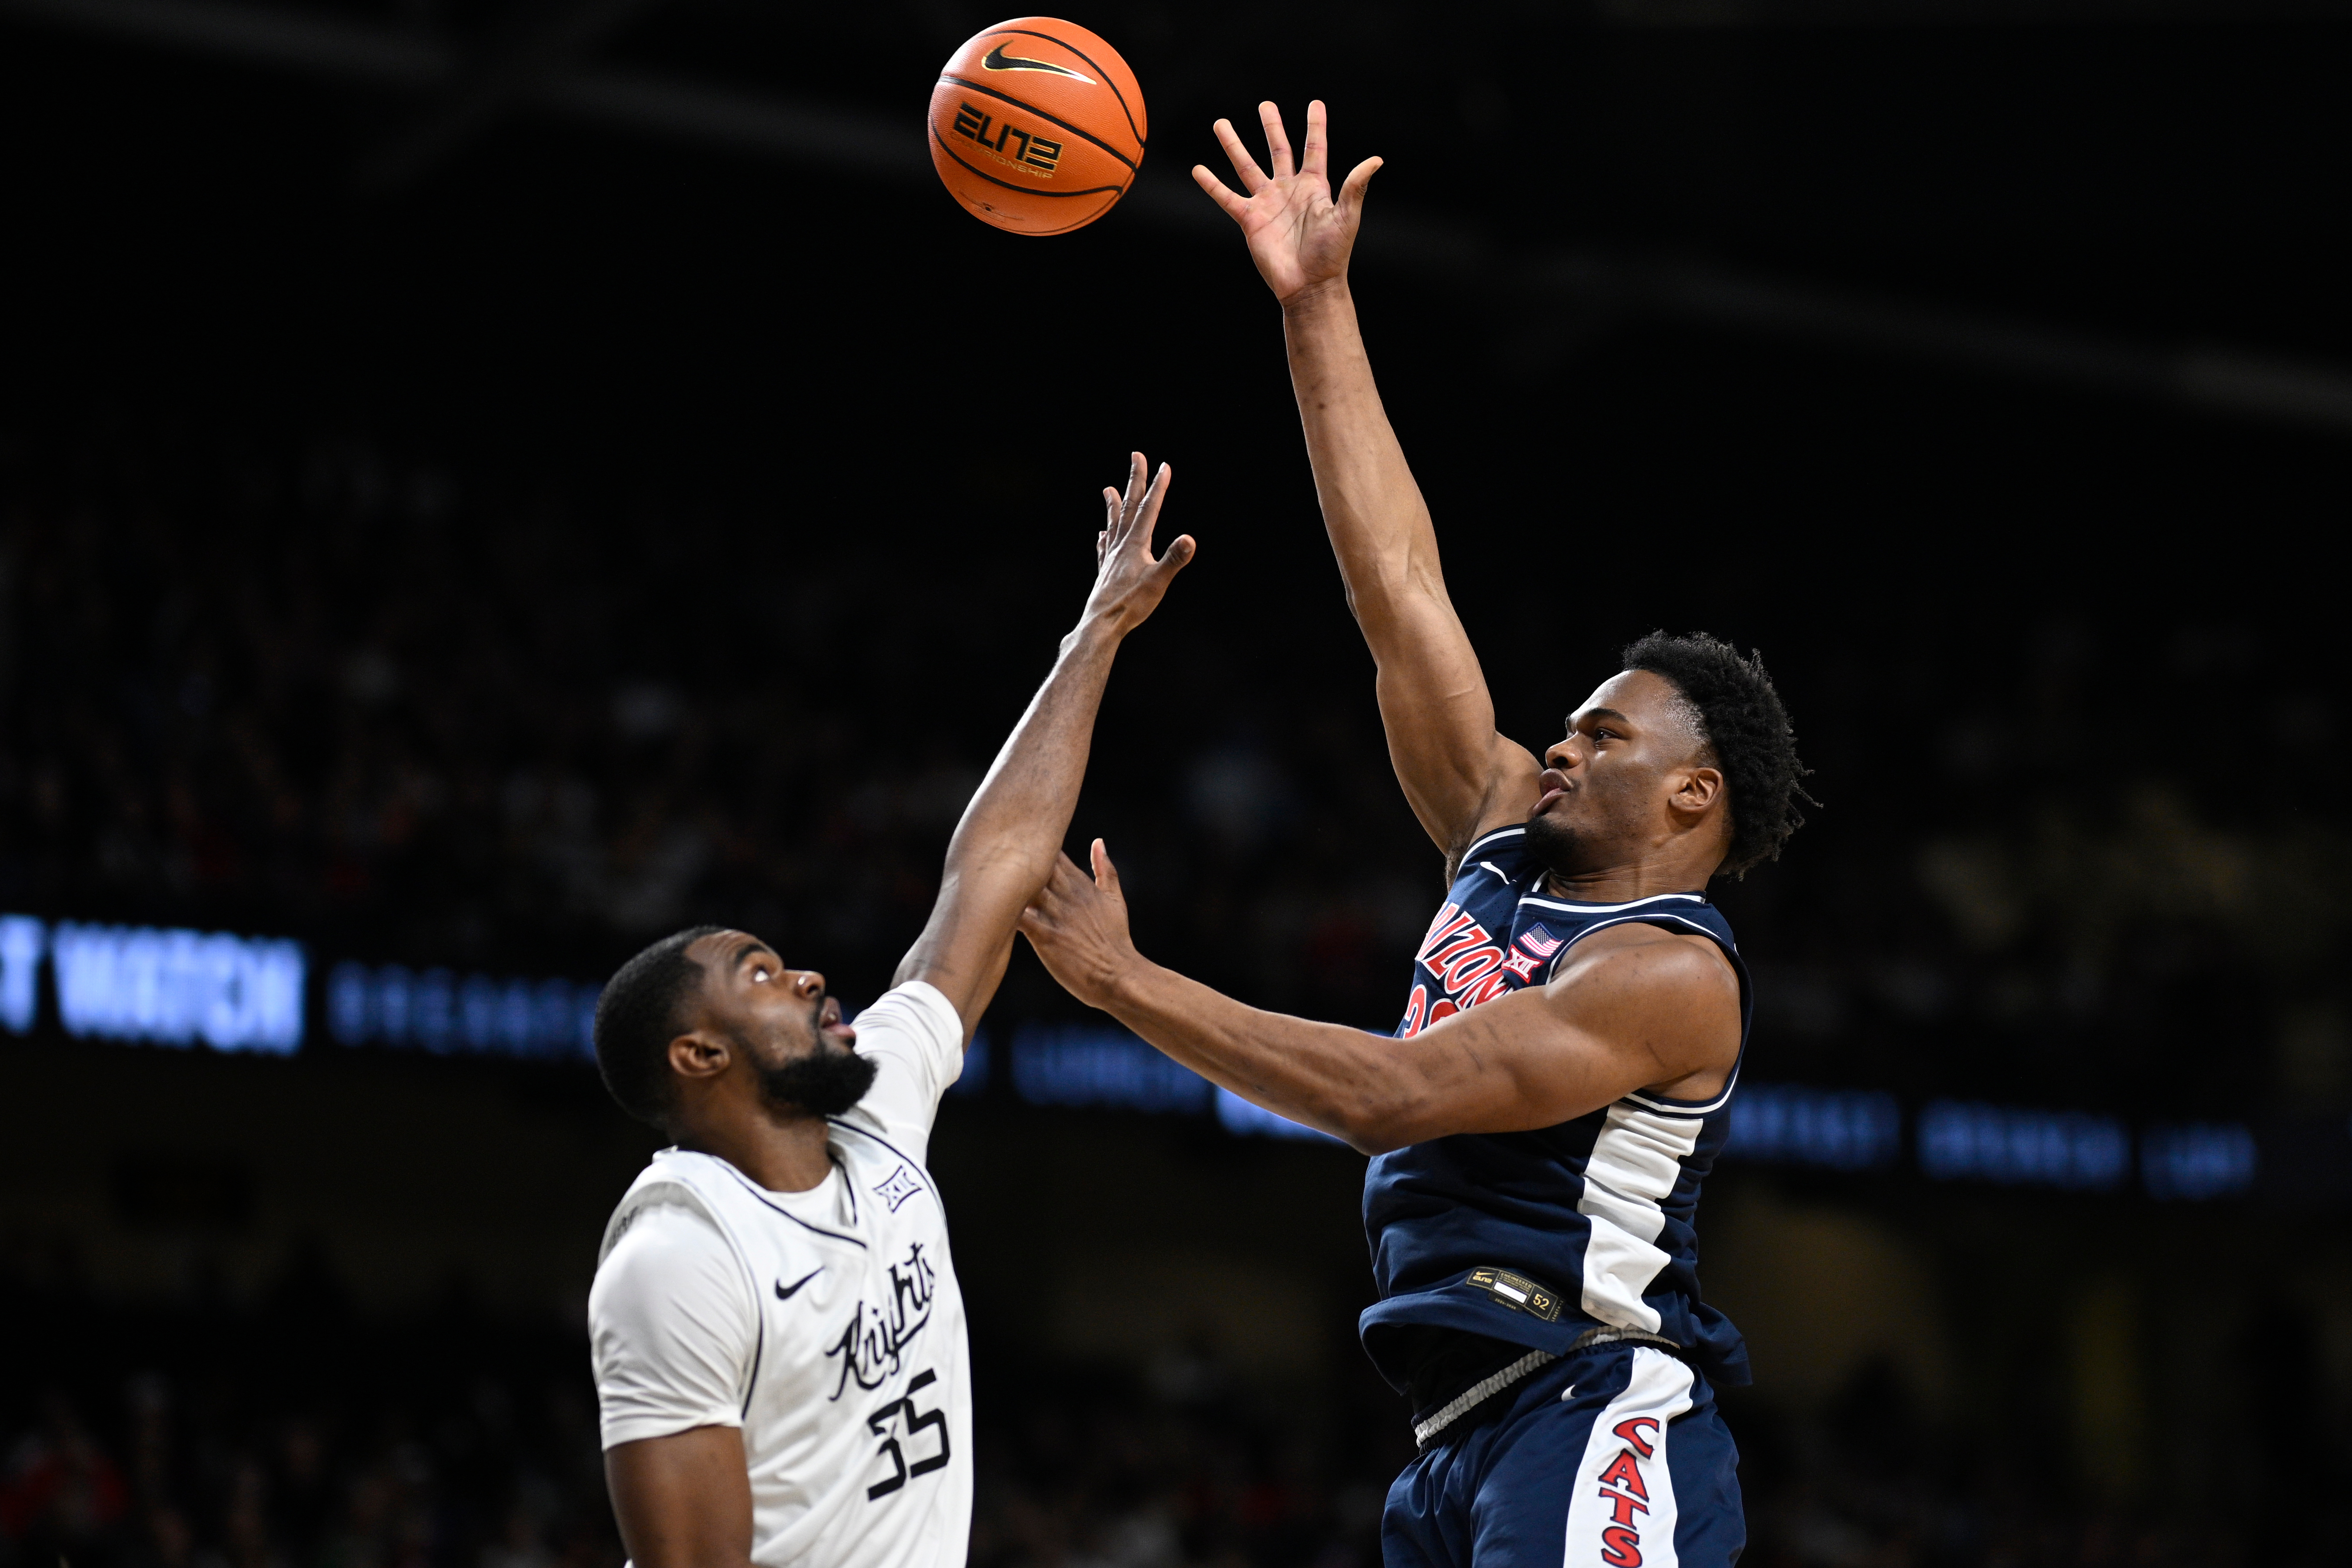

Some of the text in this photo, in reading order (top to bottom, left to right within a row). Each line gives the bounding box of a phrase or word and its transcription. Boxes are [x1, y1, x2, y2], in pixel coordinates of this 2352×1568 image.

[950, 132, 1053, 179] PIONSHIP
[952, 101, 1064, 172] ELITE
[1414, 901, 1514, 1012] RIZON
[825, 1242, 934, 1401] Knights
[1533, 1293, 1550, 1310] 52
[867, 1368, 950, 1501] 35
[1598, 1417, 1660, 1568] CATS
